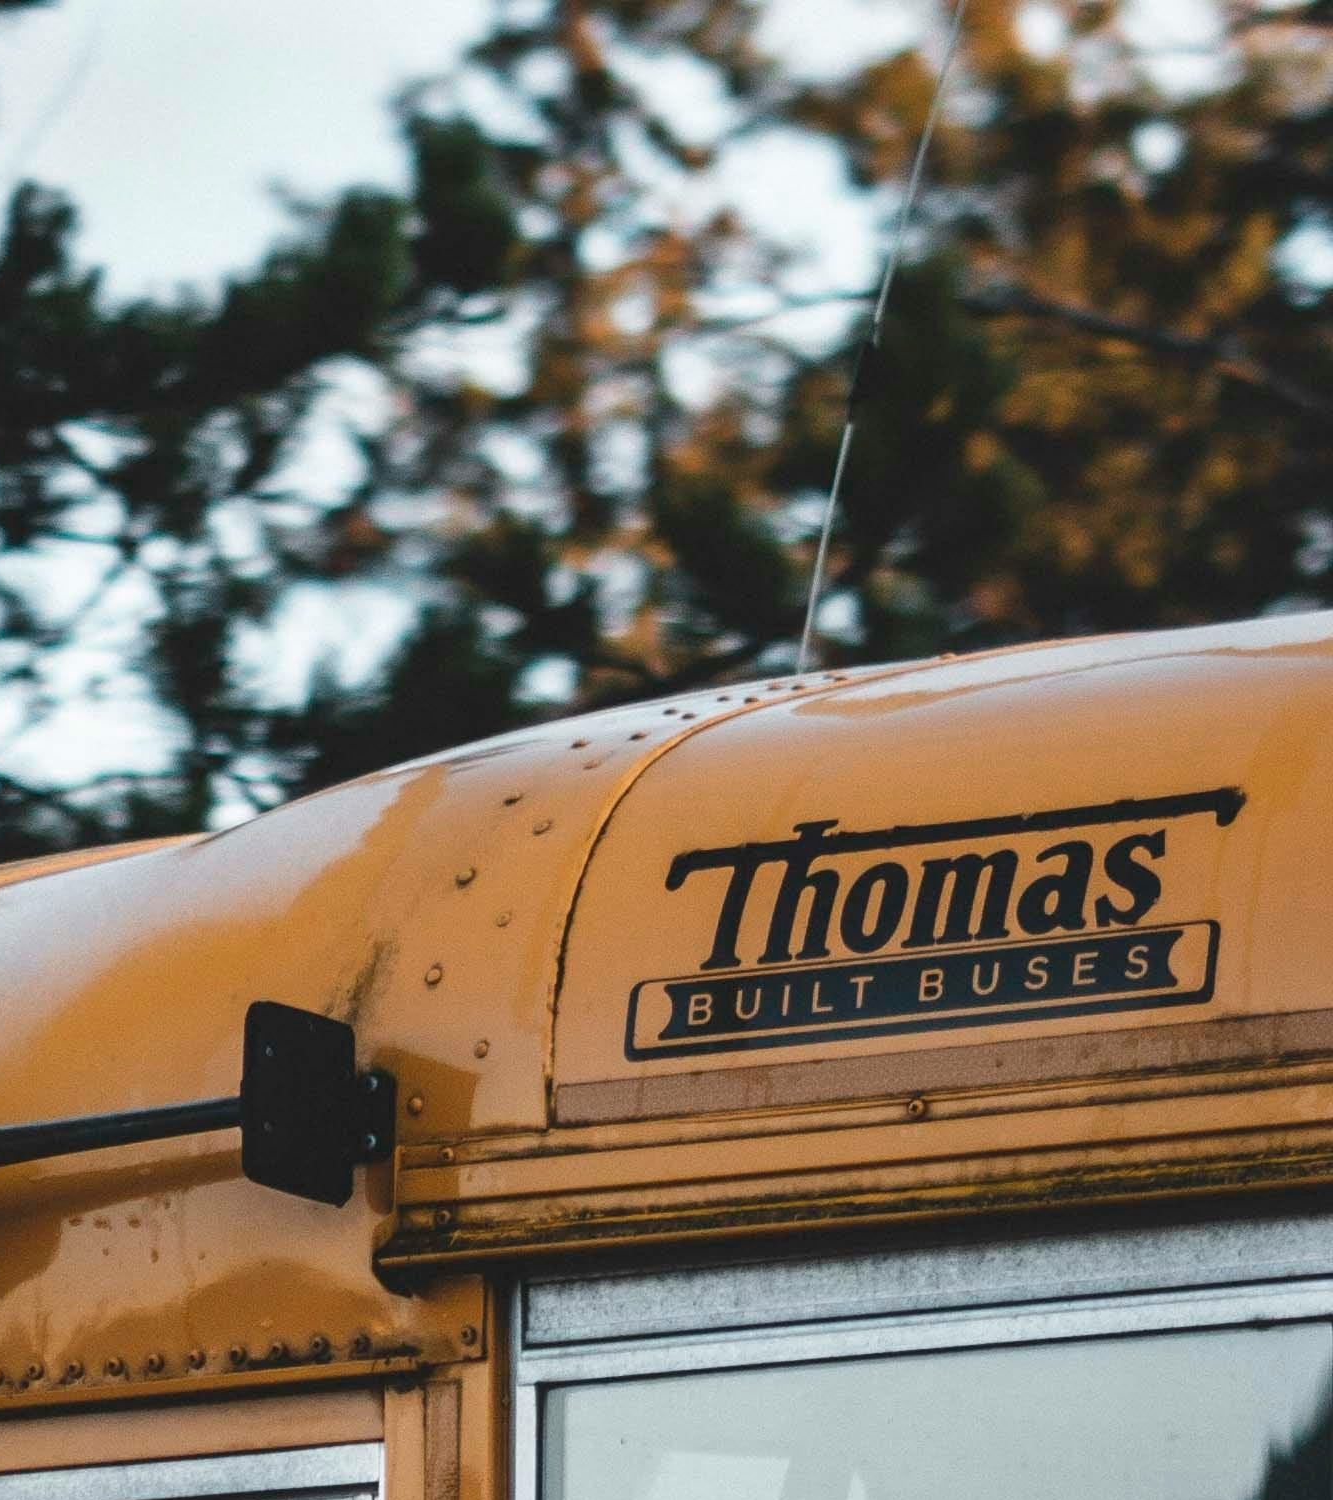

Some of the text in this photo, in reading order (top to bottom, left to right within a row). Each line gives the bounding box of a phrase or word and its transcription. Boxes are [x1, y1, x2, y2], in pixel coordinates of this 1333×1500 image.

[664, 785, 1247, 971] Thomas
[687, 944, 1151, 1026] BUILT BUSES
